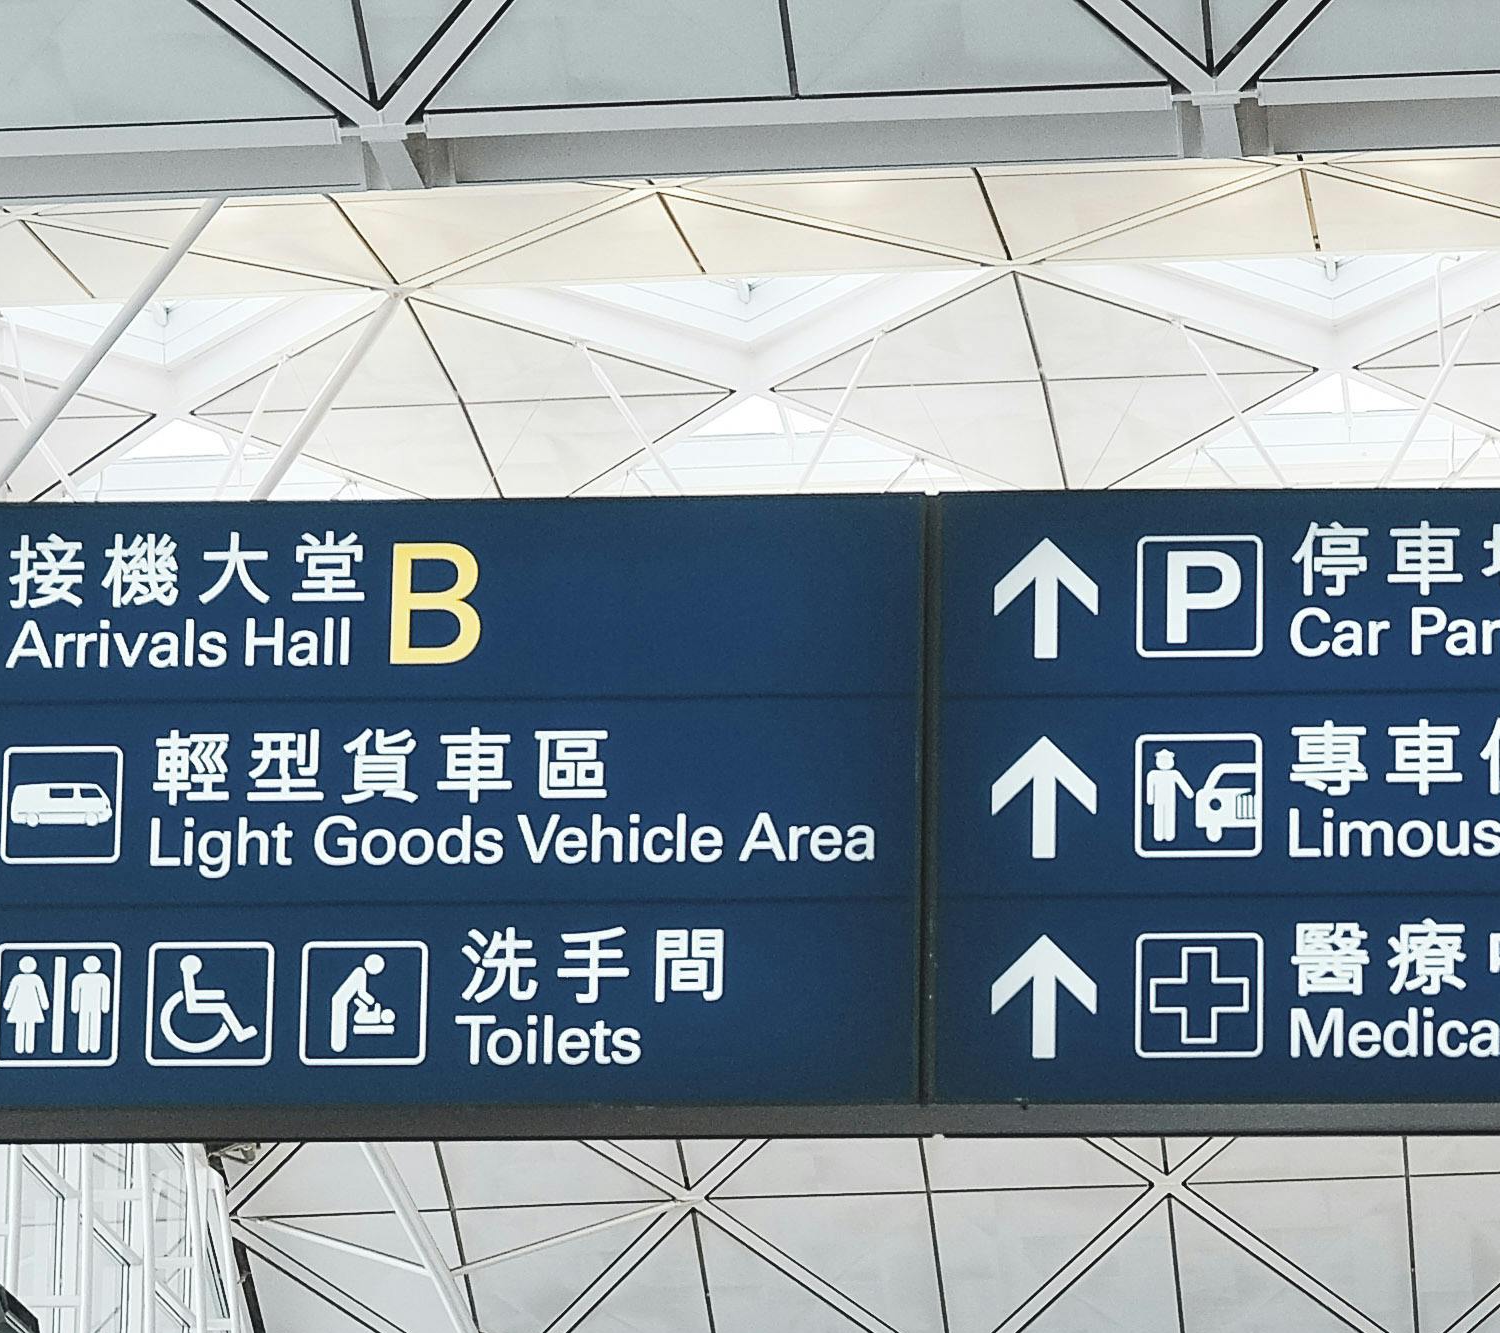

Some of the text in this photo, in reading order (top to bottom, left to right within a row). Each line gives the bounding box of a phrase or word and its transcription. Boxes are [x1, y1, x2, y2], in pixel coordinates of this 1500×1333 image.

[7, 530, 482, 666] 接機大堂 B
[5, 616, 352, 669] Arrivals Hall
[1289, 606, 1391, 658] Car
[152, 726, 610, 806] 輕型貨車區
[149, 812, 875, 879] Light Goods Vehicle Area
[461, 926, 726, 1005] 洗手間
[454, 1014, 642, 1066] Toilets
